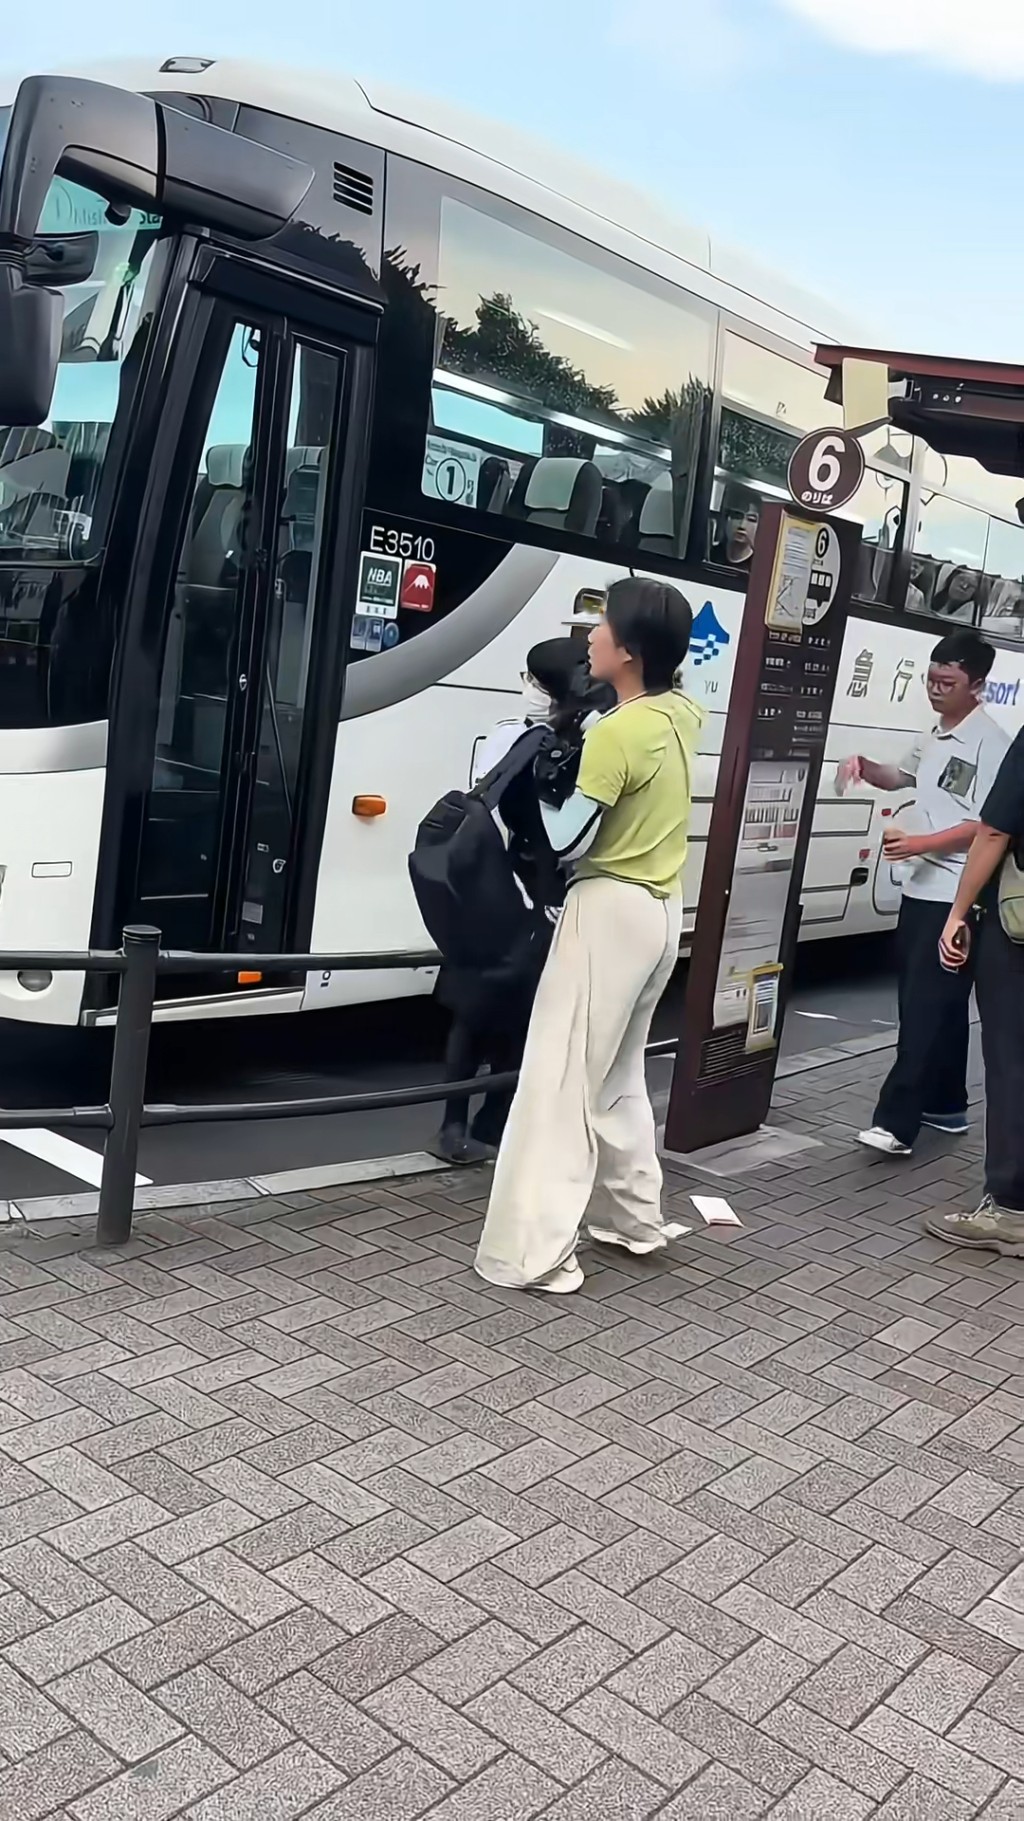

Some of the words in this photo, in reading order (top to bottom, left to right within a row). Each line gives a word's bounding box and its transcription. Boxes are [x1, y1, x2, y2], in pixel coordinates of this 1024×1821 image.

[808, 435, 846, 492] 6
[801, 491, 833, 505] のりば
[370, 525, 435, 561] E3510
[367, 567, 392, 587] NBA
